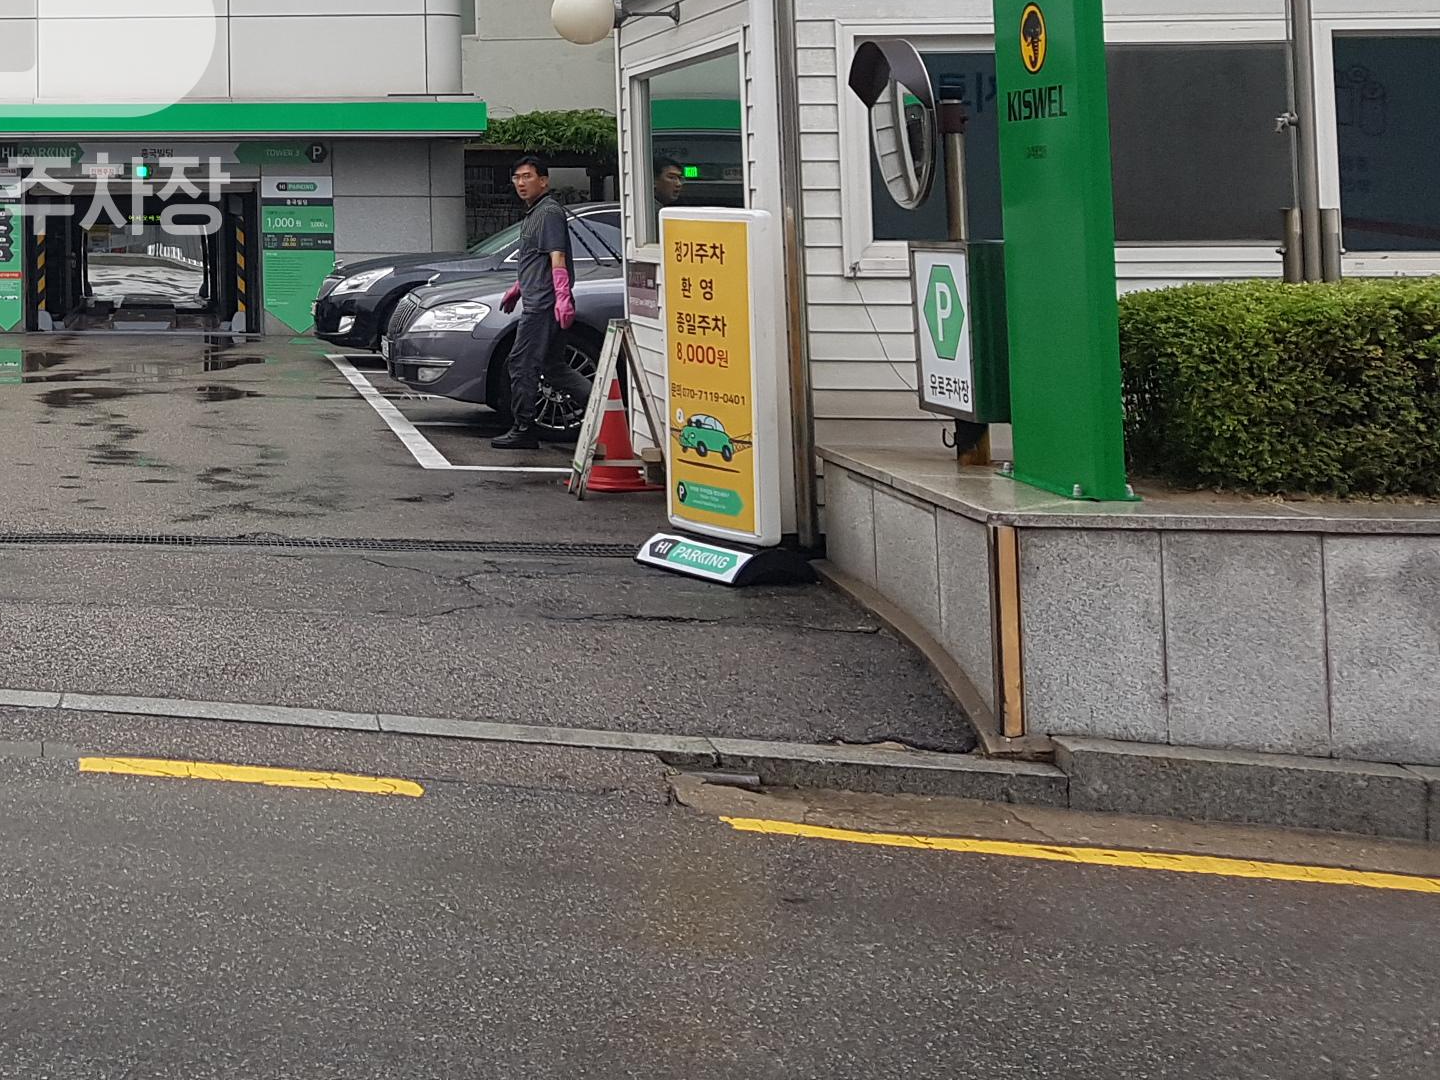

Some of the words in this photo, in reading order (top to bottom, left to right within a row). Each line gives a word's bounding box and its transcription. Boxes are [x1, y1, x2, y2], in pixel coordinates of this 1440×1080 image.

[1007, 84, 1068, 122] KISWEL
[312, 146, 323, 160] P
[673, 240, 726, 265] 정기주차
[676, 311, 727, 338] 종일주차
[935, 282, 953, 343] P
[676, 341, 729, 369] 8,000원
[930, 373, 970, 404] 유료주차장
[654, 541, 673, 555] HI
[672, 546, 730, 570] PARKING
